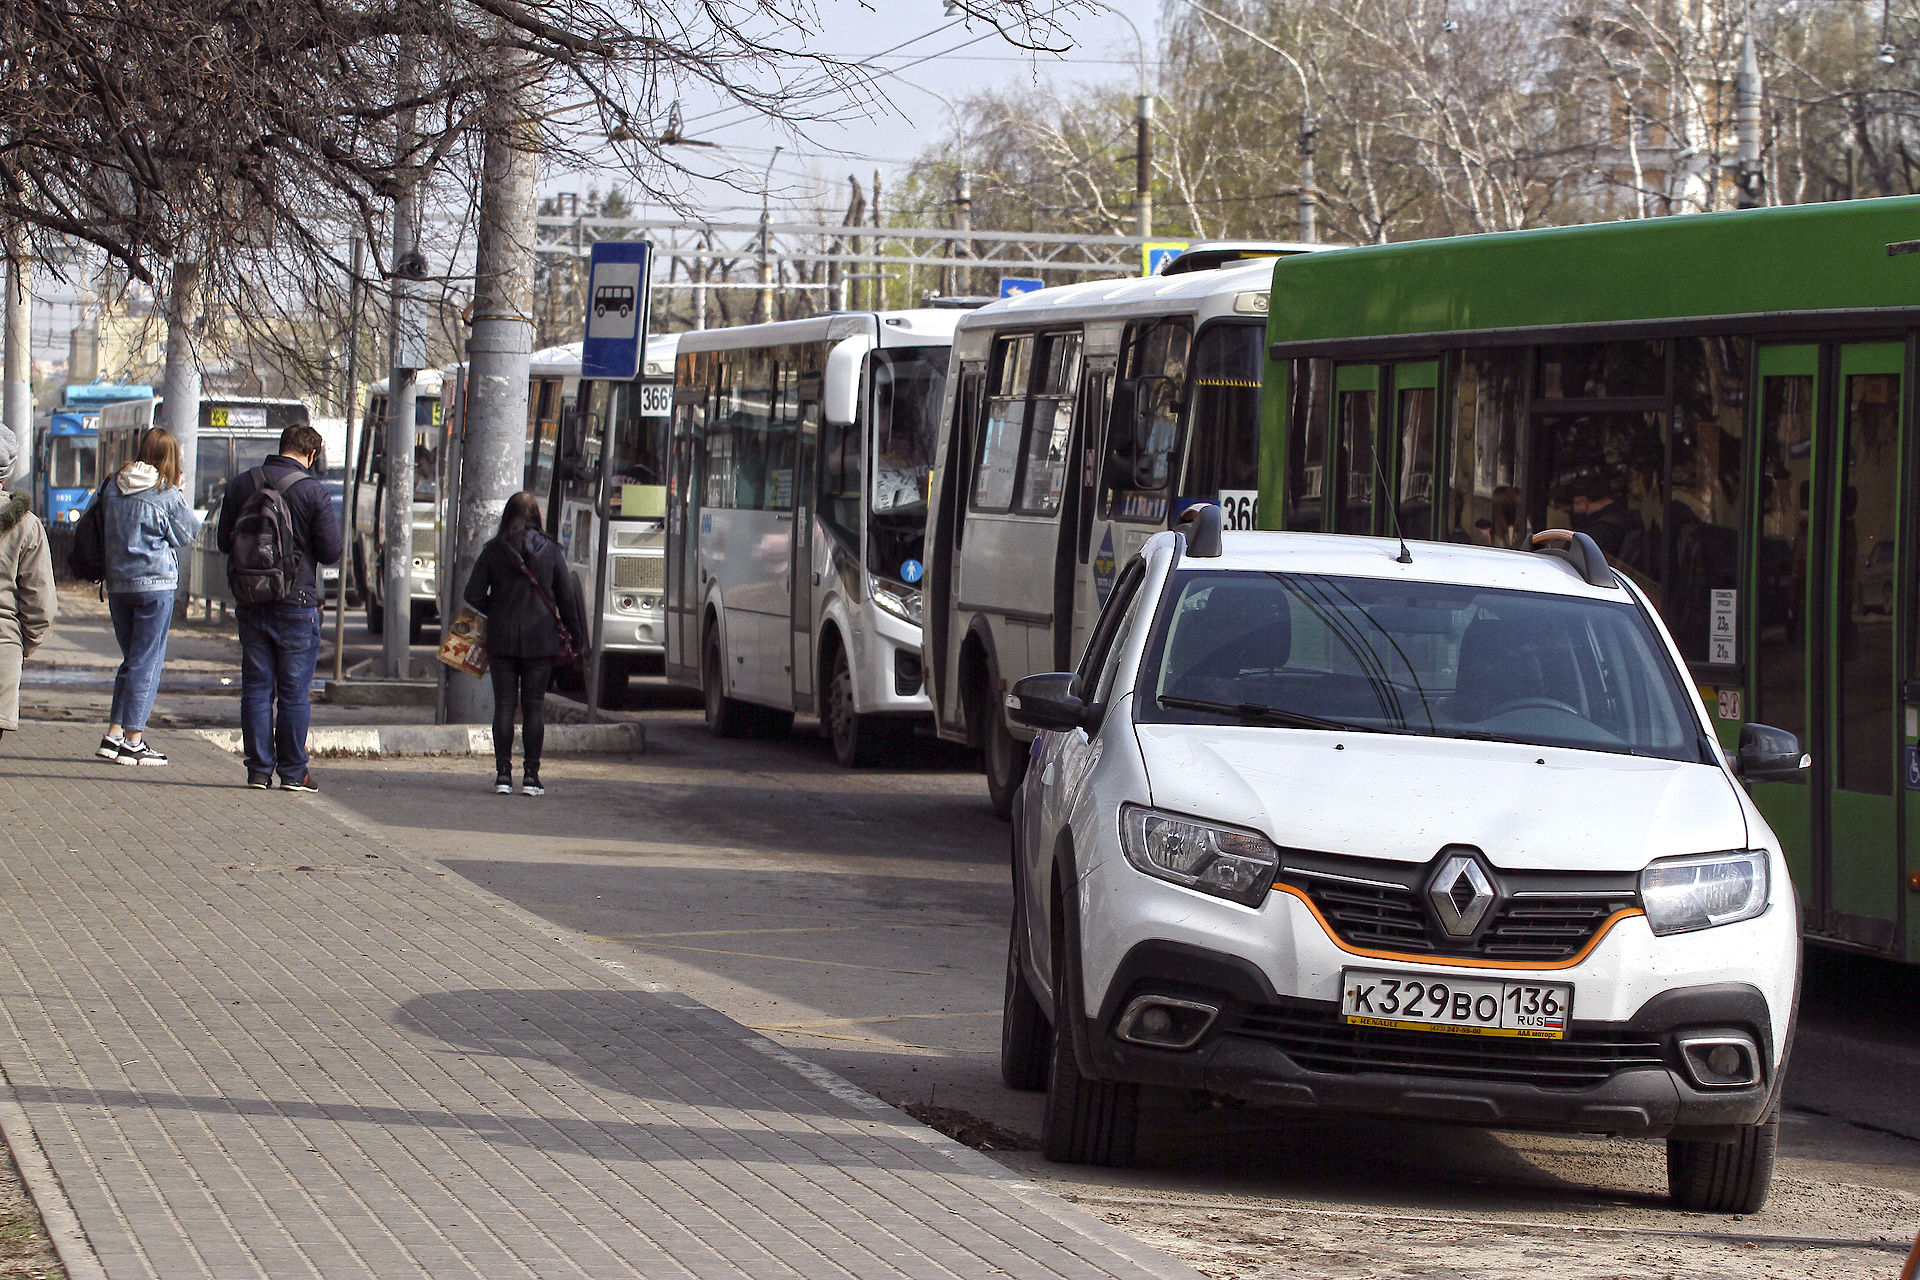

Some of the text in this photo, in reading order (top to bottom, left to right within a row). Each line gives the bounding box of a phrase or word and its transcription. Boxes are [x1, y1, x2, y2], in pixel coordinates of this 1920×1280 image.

[1507, 987, 1559, 1015] 136
[1360, 1018, 1400, 1028] RENAULT
[1517, 1015, 1544, 1026] RUS
